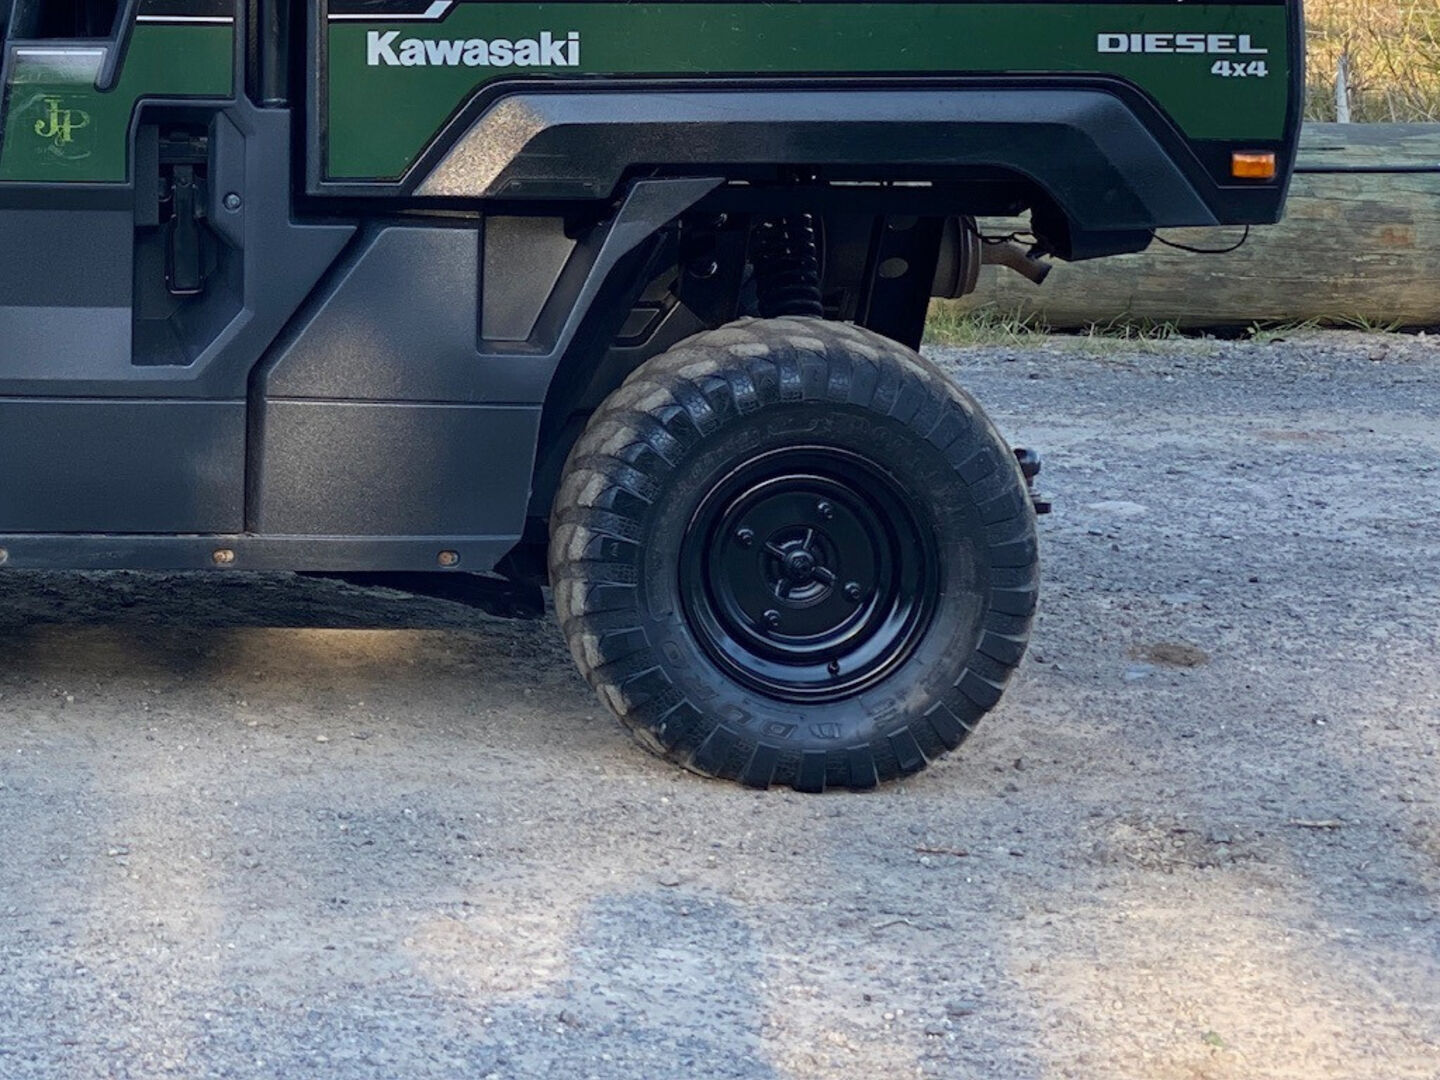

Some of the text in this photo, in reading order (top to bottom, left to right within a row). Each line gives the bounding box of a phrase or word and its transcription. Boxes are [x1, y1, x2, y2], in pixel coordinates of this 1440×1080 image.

[367, 30, 580, 67] Kawasaki
[1098, 33, 1268, 53] DIESEL
[1211, 60, 1268, 77] 4x4
